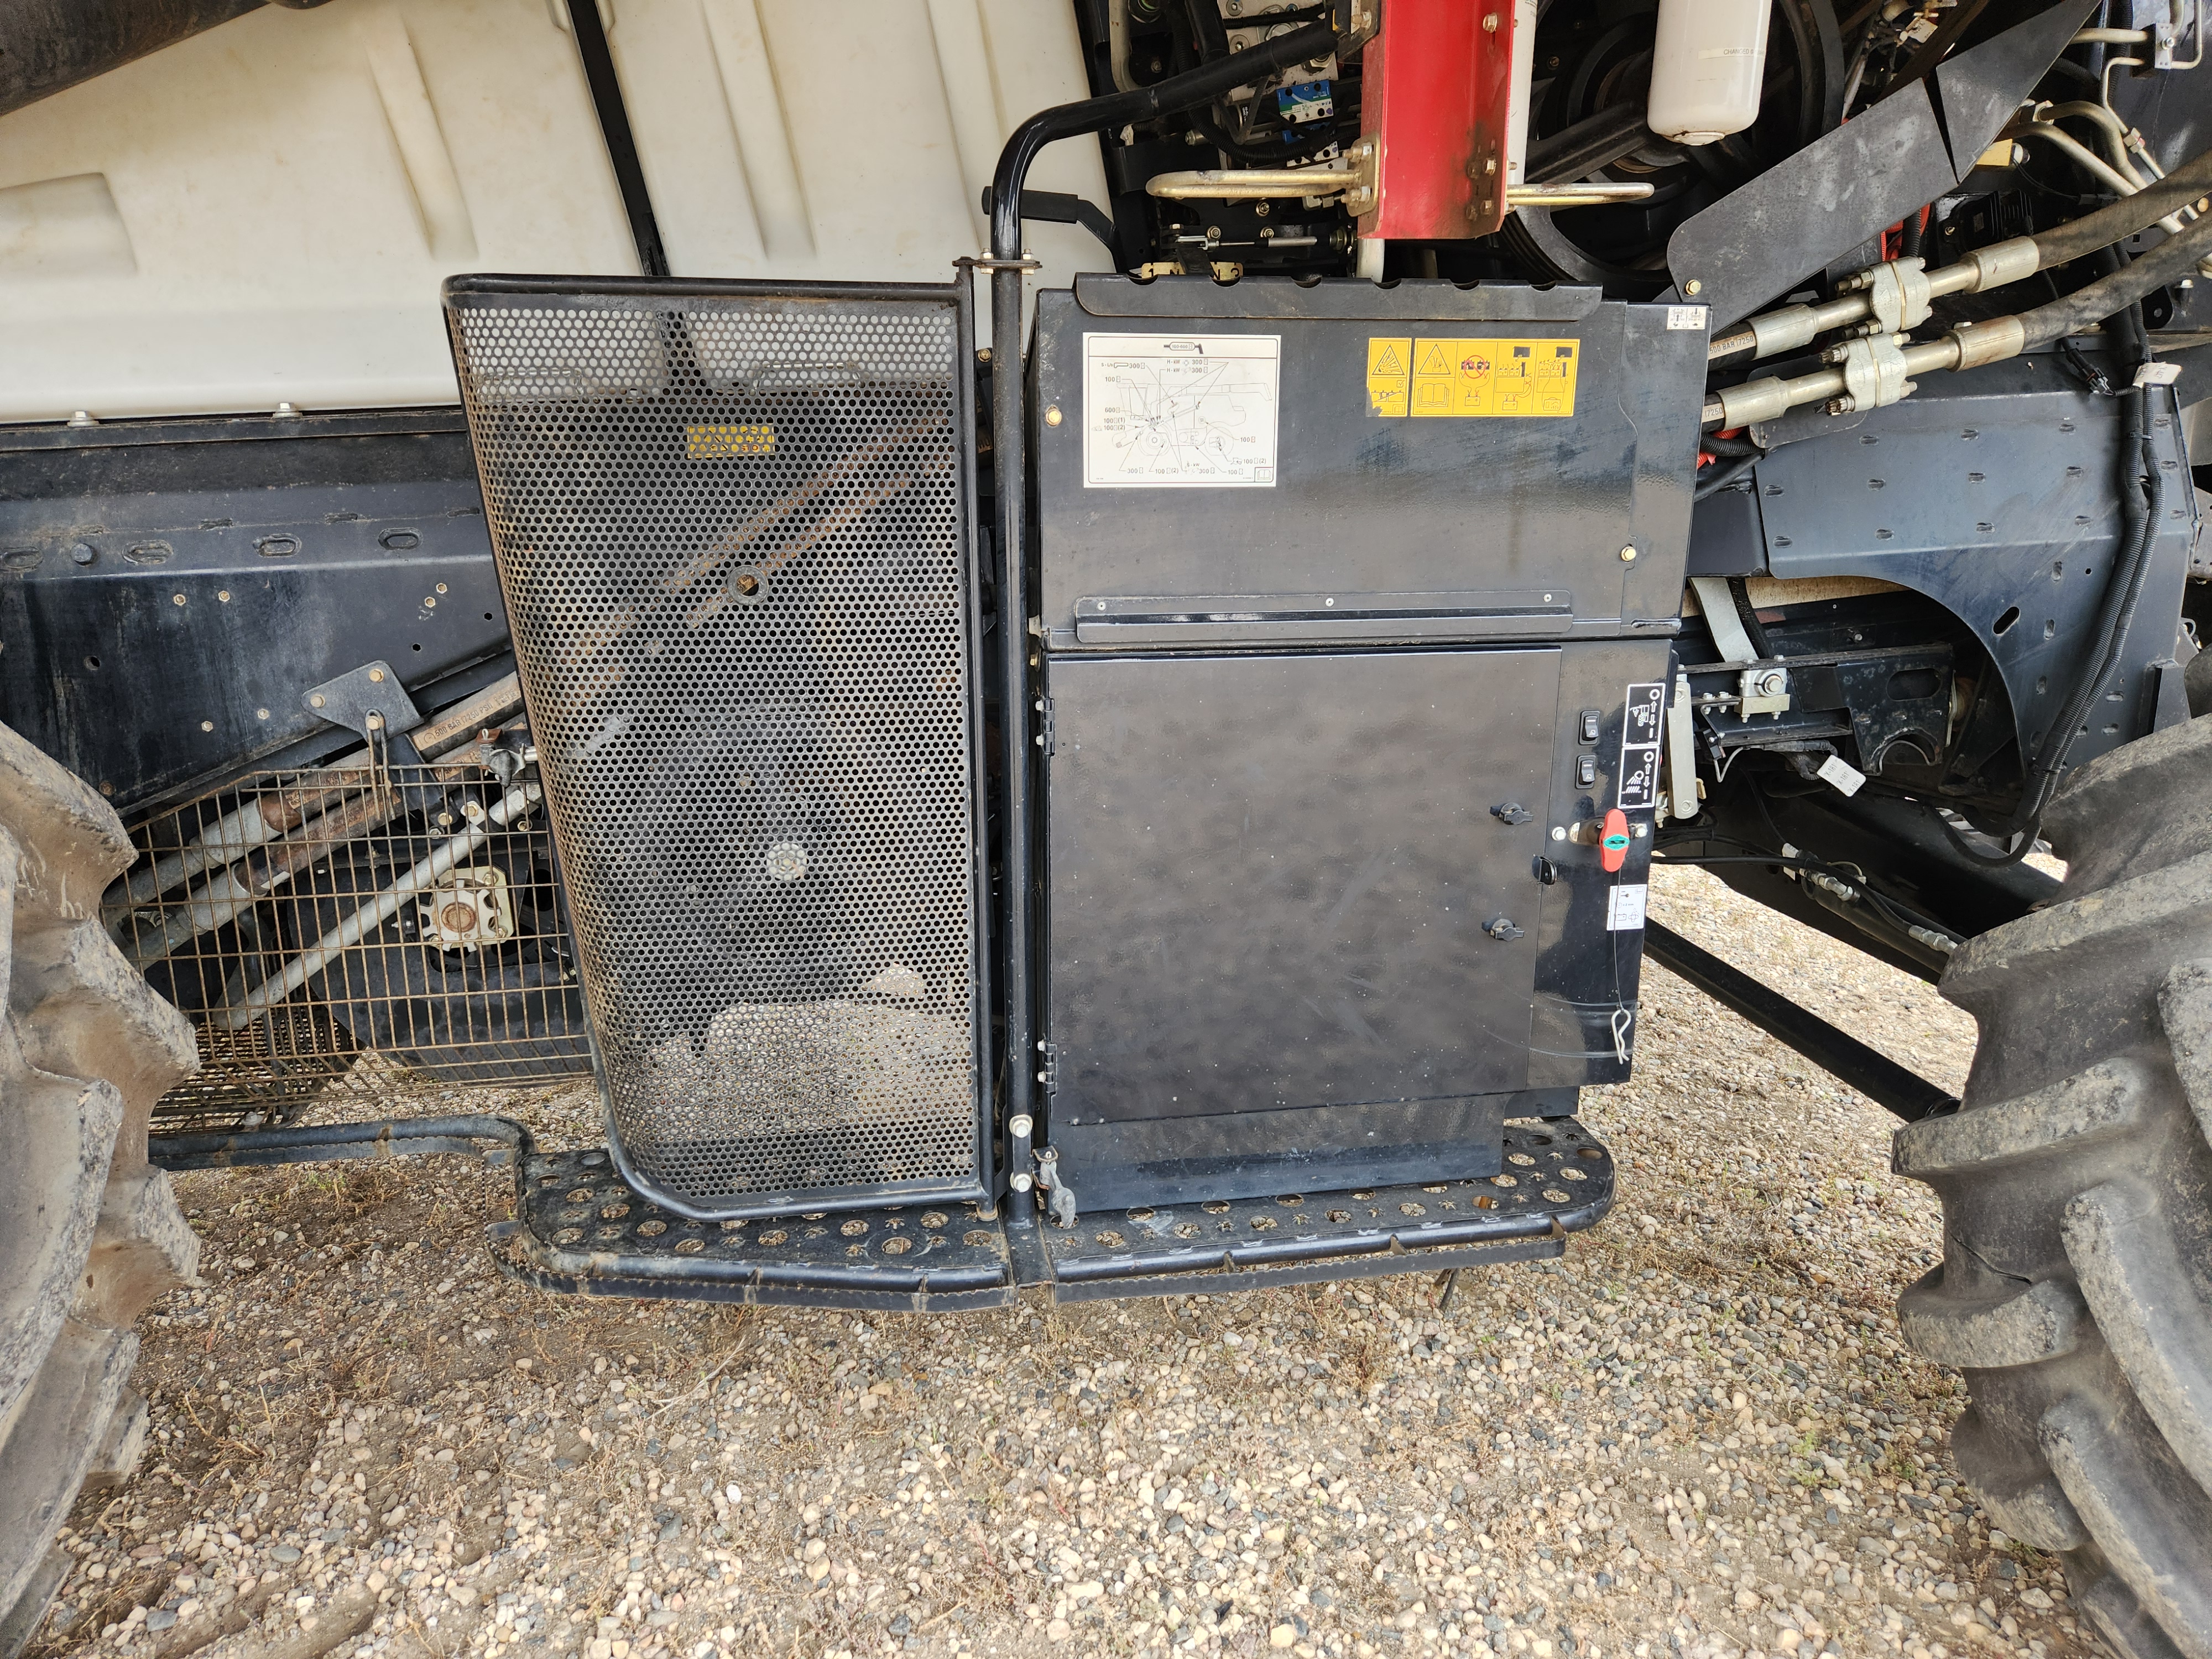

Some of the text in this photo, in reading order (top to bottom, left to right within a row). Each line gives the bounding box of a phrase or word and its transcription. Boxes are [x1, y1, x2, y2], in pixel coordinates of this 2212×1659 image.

[1709, 345, 1721, 354] 500
[1722, 341, 1735, 350] BAR
[435, 726, 447, 737] 500
[447, 719, 462, 731] BAR
